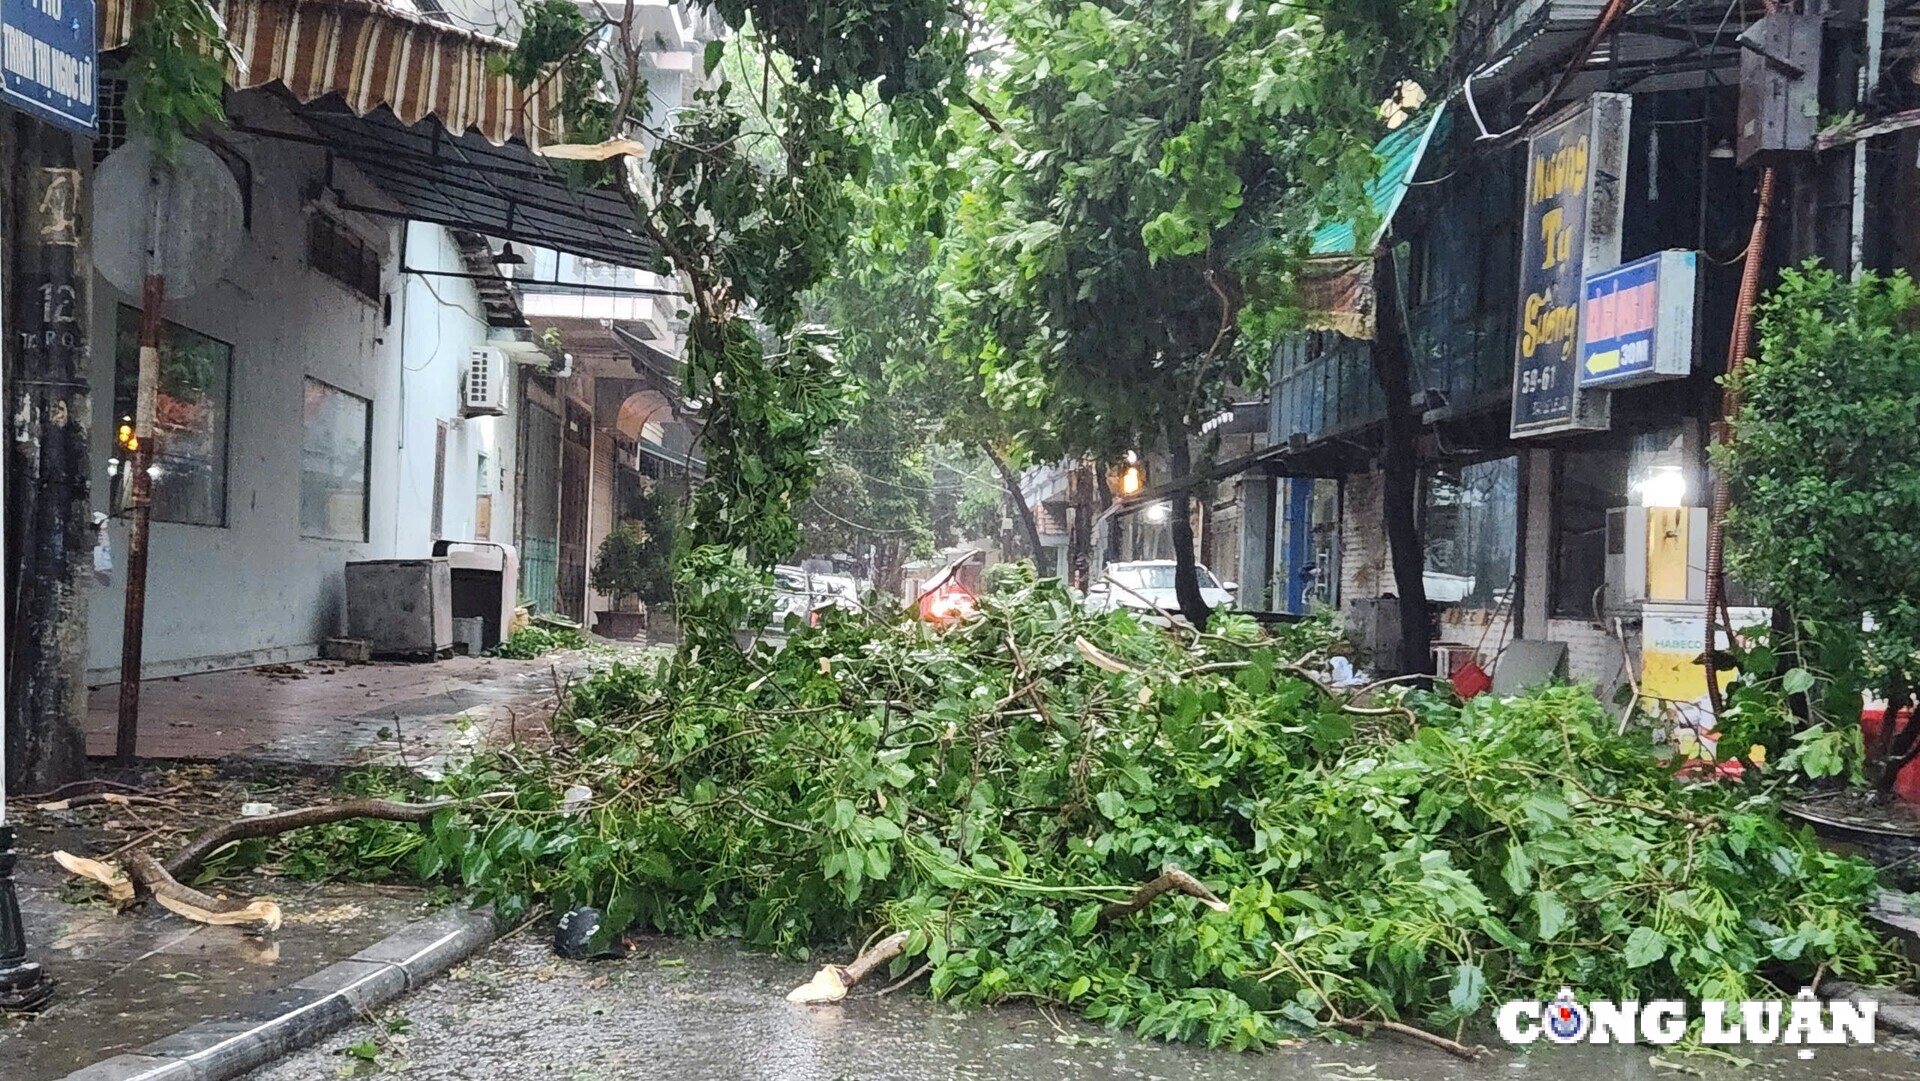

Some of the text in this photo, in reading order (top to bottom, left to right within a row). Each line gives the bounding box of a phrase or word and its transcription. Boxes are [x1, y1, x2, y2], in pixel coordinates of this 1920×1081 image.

[3, 22, 35, 84] TRỊNH
[34, 38, 51, 98] THỊ
[51, 47, 78, 107] NGỌC
[39, 282, 75, 322] 12
[1521, 365, 1557, 394] 59-61
[1655, 640, 1703, 649] HABECO
